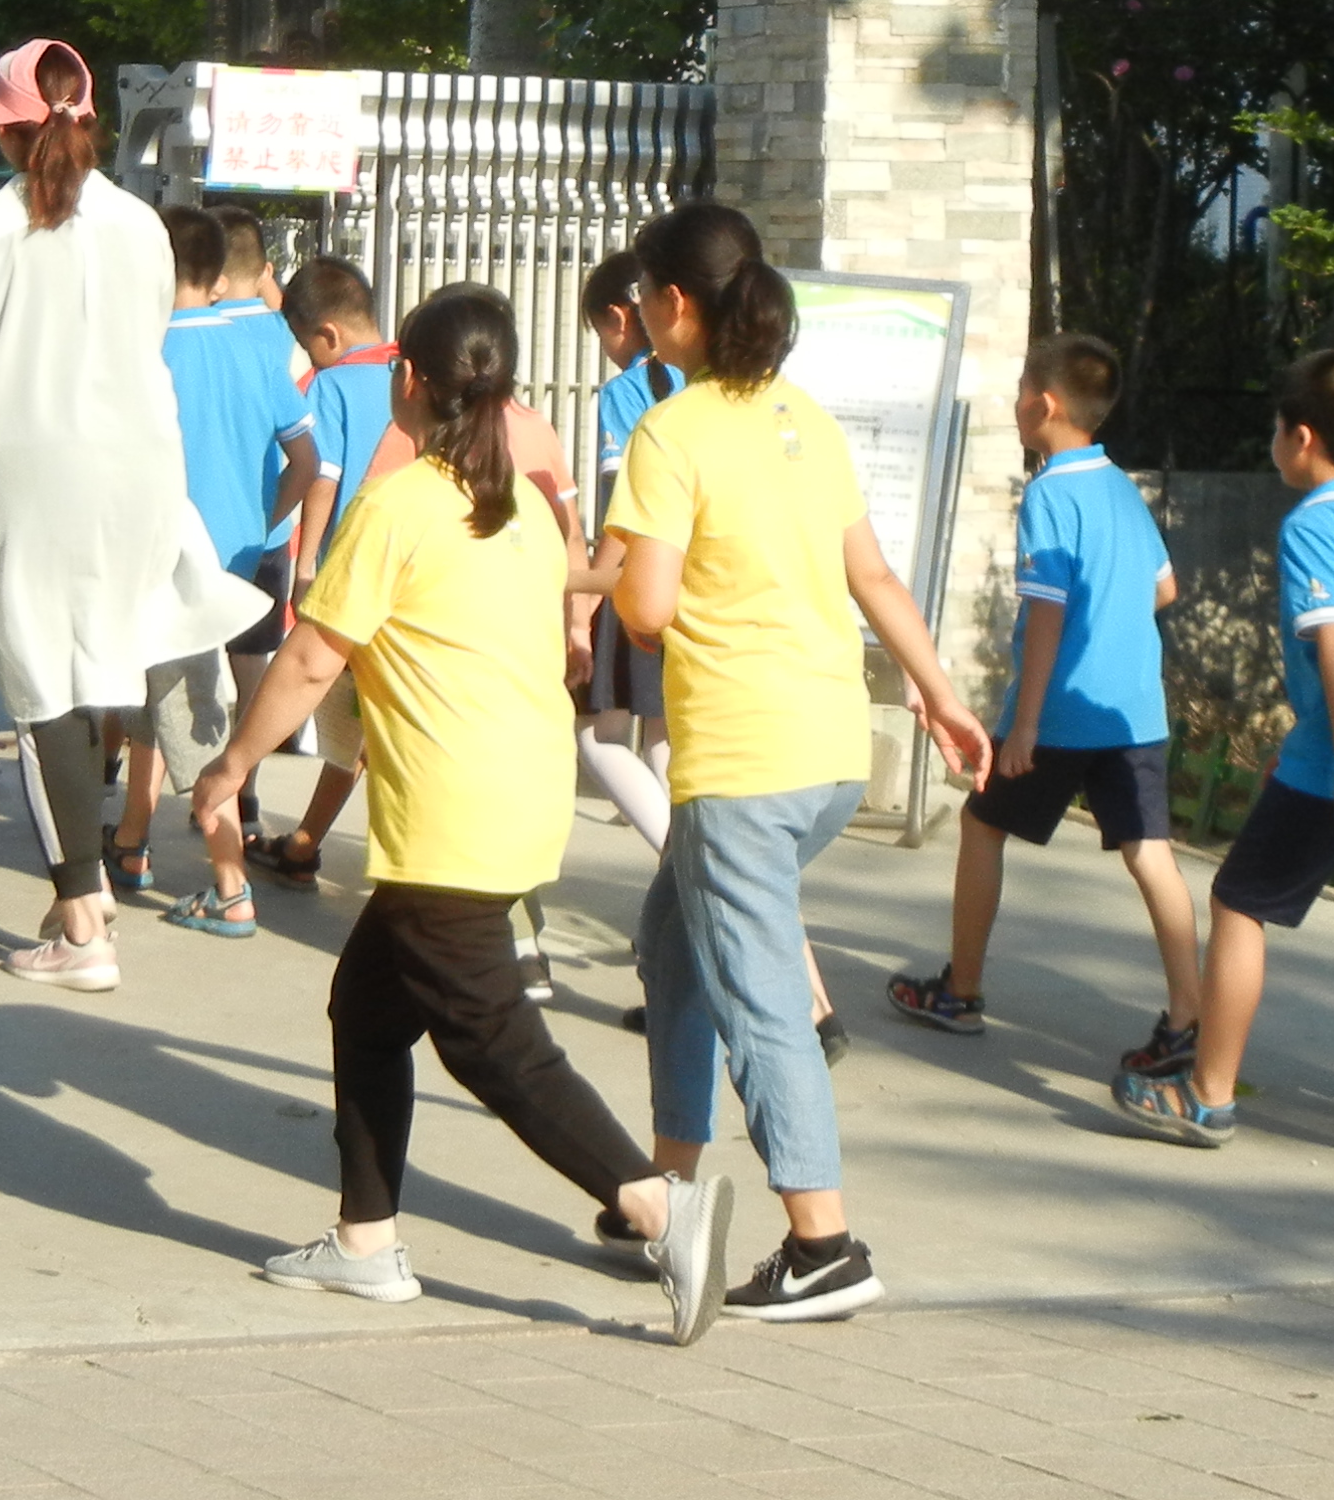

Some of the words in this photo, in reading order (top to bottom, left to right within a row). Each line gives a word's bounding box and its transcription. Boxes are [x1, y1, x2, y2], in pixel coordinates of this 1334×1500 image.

[226, 111, 344, 139] 请勿靠近
[224, 147, 342, 175] 禁止攀爬
